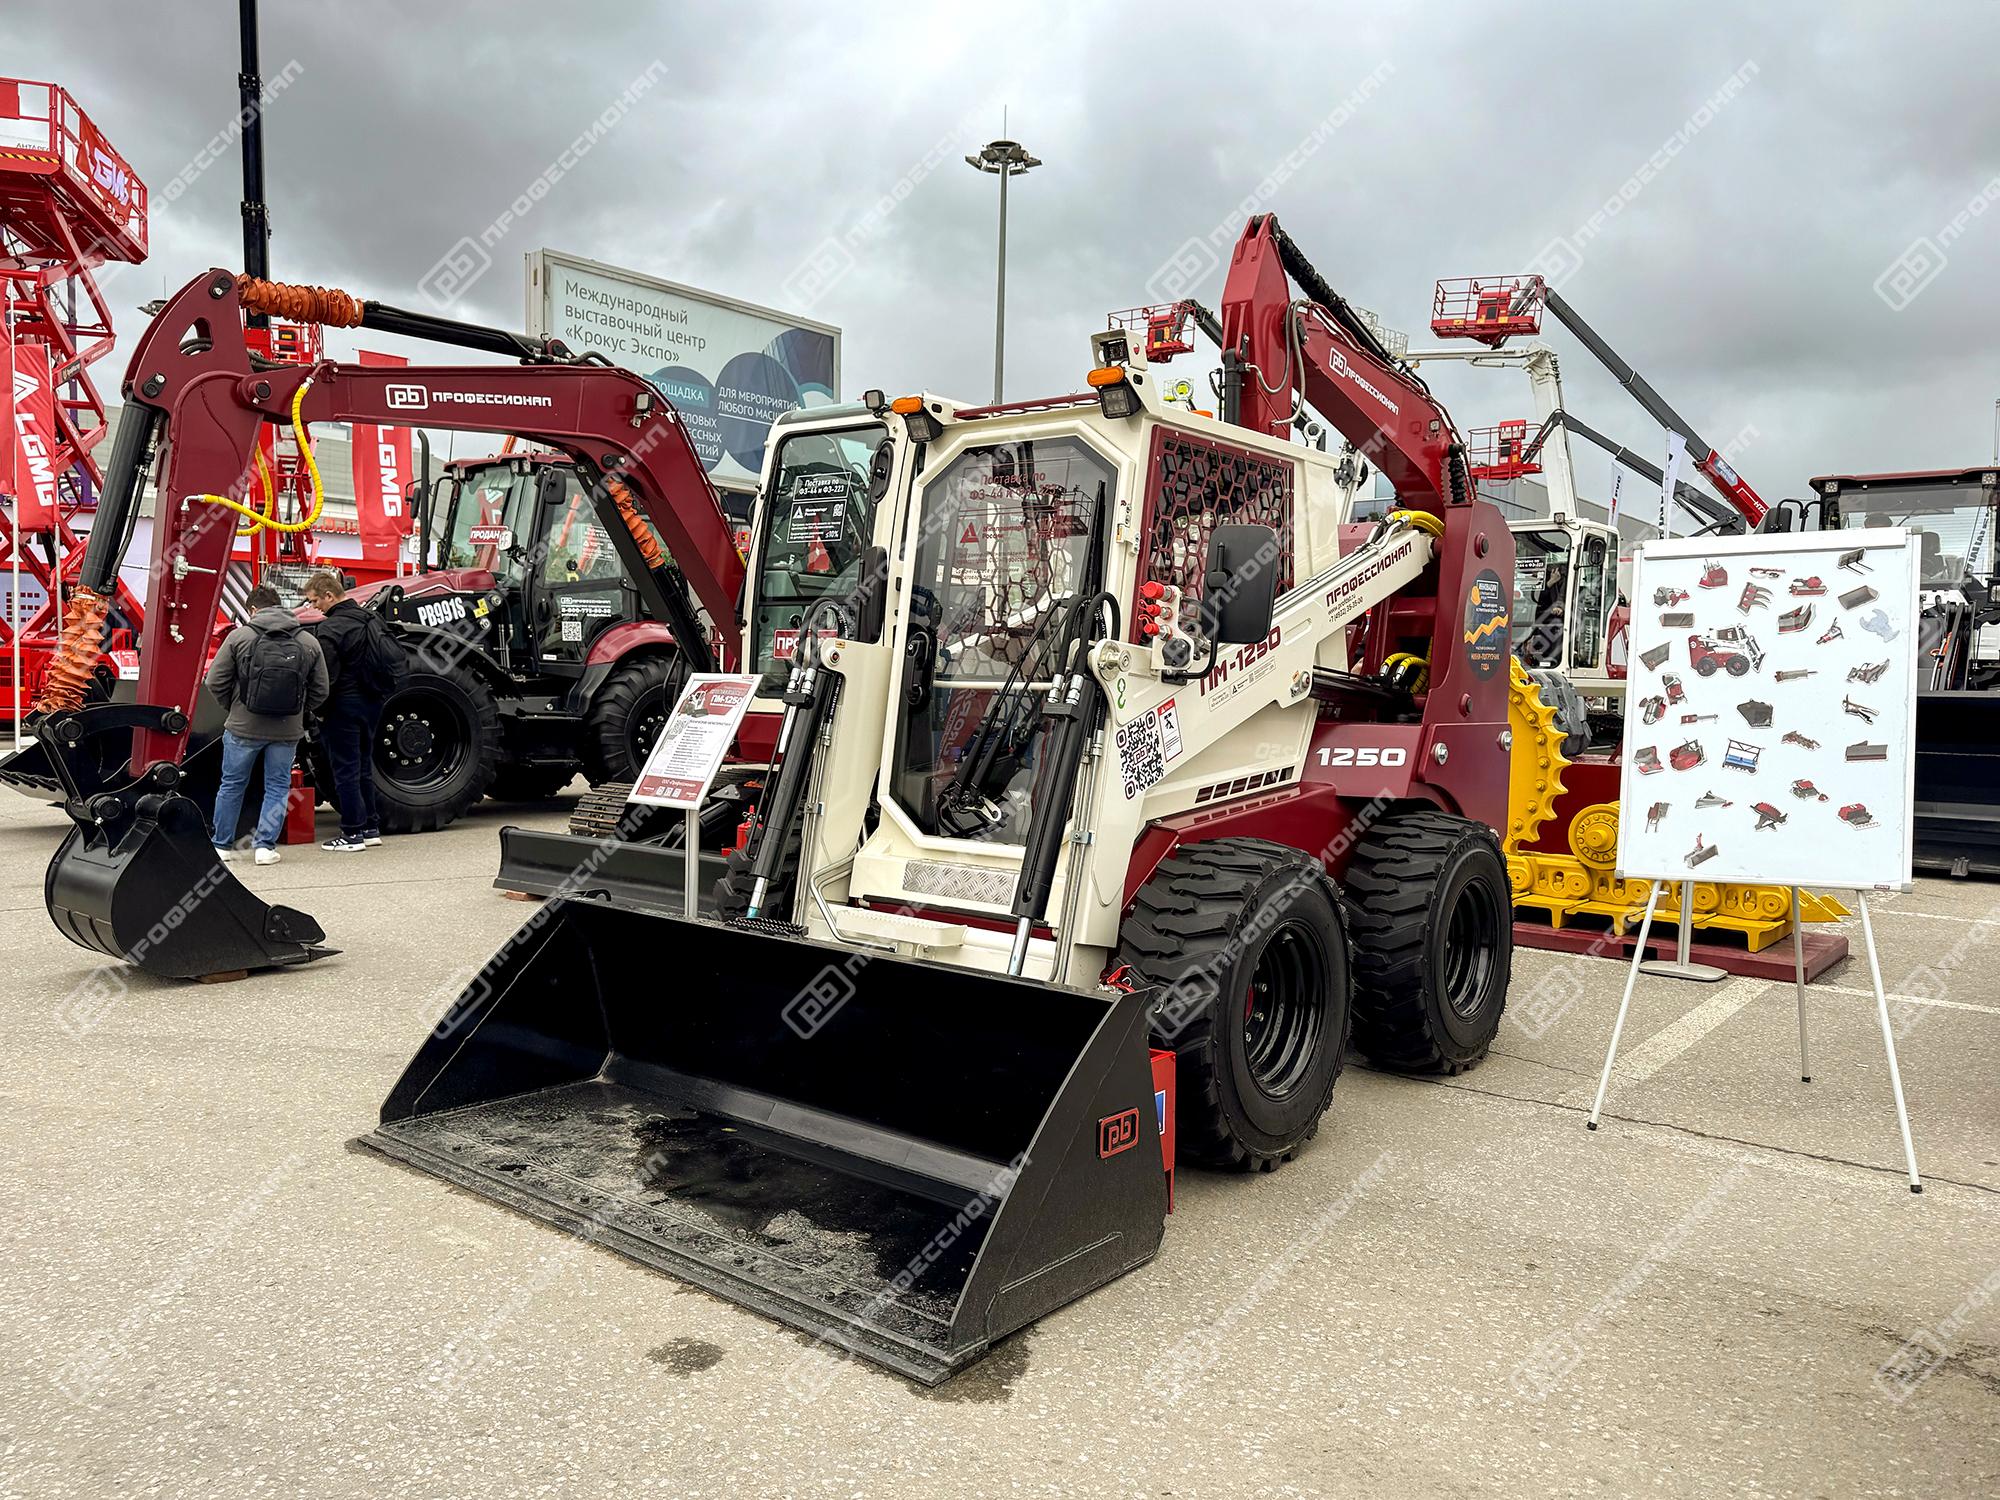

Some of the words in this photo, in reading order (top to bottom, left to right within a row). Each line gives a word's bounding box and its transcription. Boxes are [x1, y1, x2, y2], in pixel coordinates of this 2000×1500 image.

[565, 280, 688, 325] Международный
[565, 305, 662, 339] выставочный
[667, 330, 706, 352] центр
[565, 325, 626, 352] «Крокус
[631, 338, 680, 362] Экспо»
[432, 391, 553, 407] ПРОФЕССИОНАЛ
[652, 380, 704, 402] ЛОЩАДКА
[718, 386, 736, 399] ДЛЯ
[1346, 367, 1399, 416] ПРОФЕССИОНАЛ
[679, 412, 717, 428] ЕЛОВЫХ
[718, 401, 754, 416] ЛЮБОГО
[688, 428, 722, 443] ЕССНЫХ
[16, 412, 56, 506] LGMG
[376, 425, 402, 517] LGMG
[1326, 541, 1412, 608] ПРОФЕССИОНАЛ
[417, 596, 466, 627] PB991S
[1316, 747, 1407, 766] 1250
